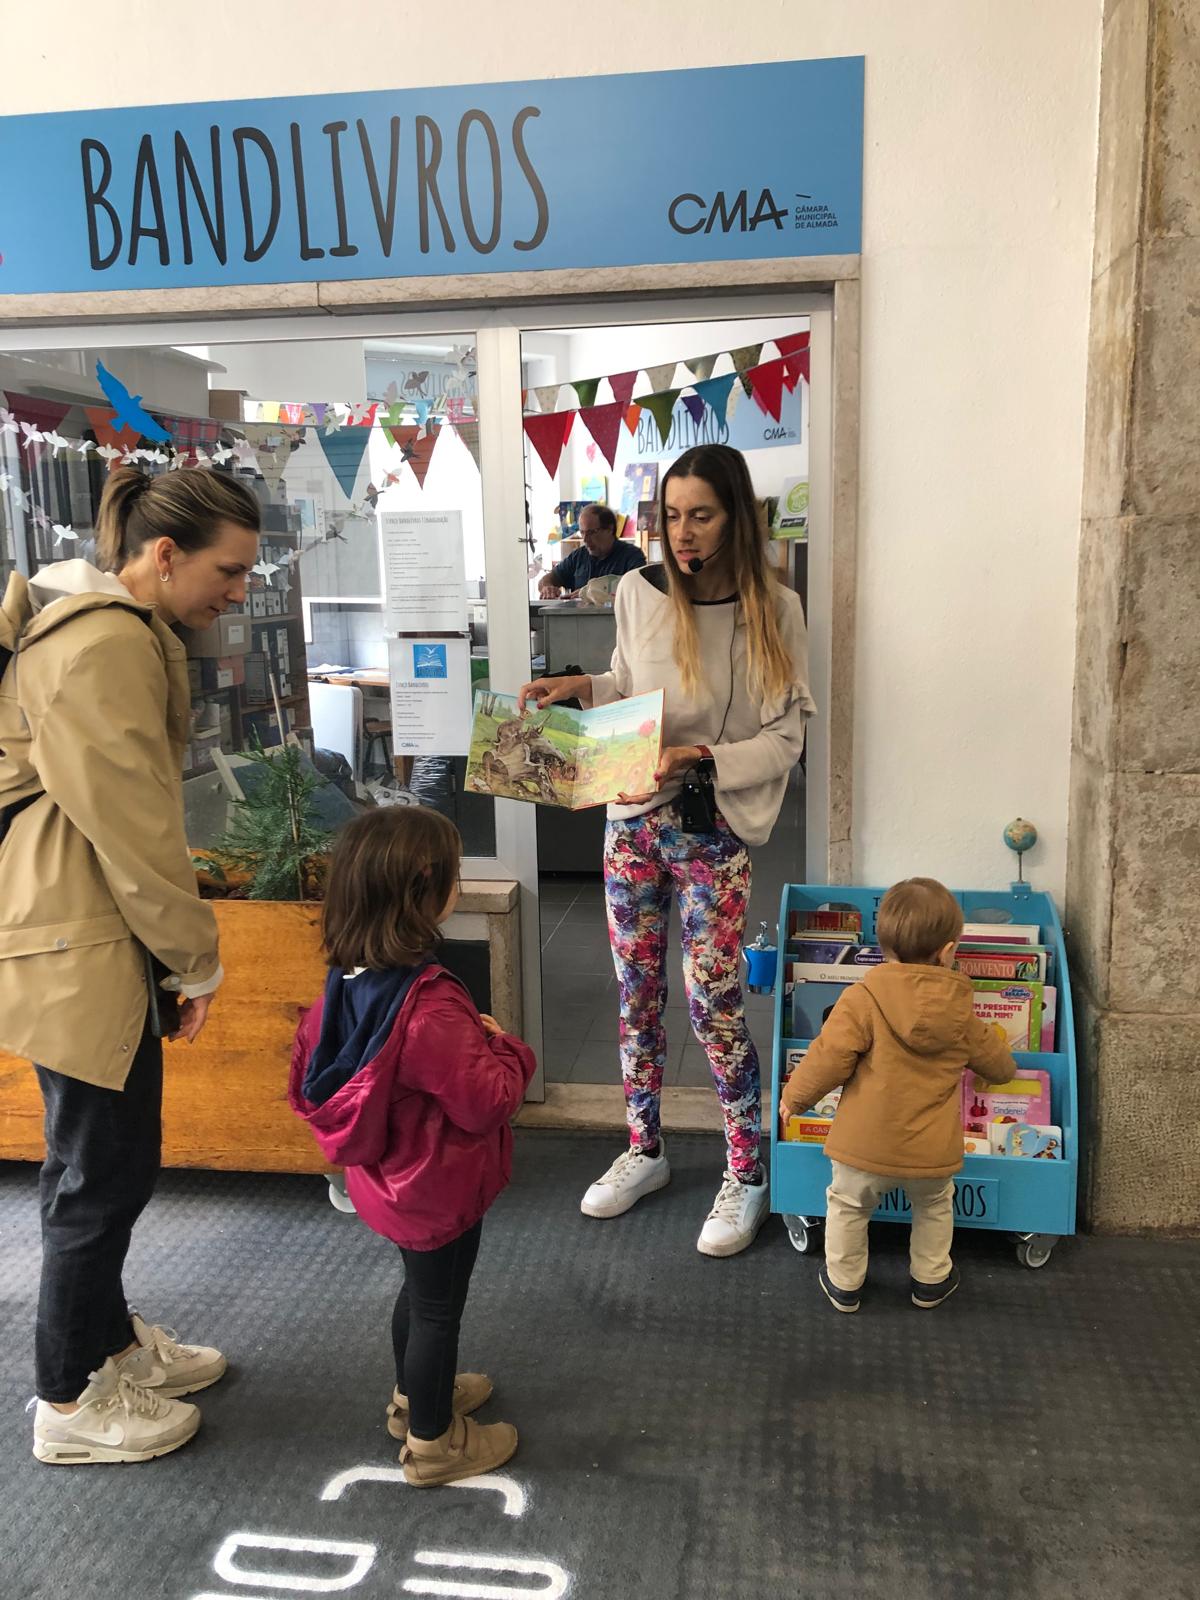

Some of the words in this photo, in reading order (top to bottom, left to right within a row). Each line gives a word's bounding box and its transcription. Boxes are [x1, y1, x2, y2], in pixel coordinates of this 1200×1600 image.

[81, 106, 549, 270] BANDLIVROS
[668, 188, 788, 234] CMA
[795, 213, 837, 221] MUNICIPAL
[806, 220, 838, 228] ALMADA
[763, 428, 787, 441] CMA
[983, 1003, 1023, 1011] PRESENTE
